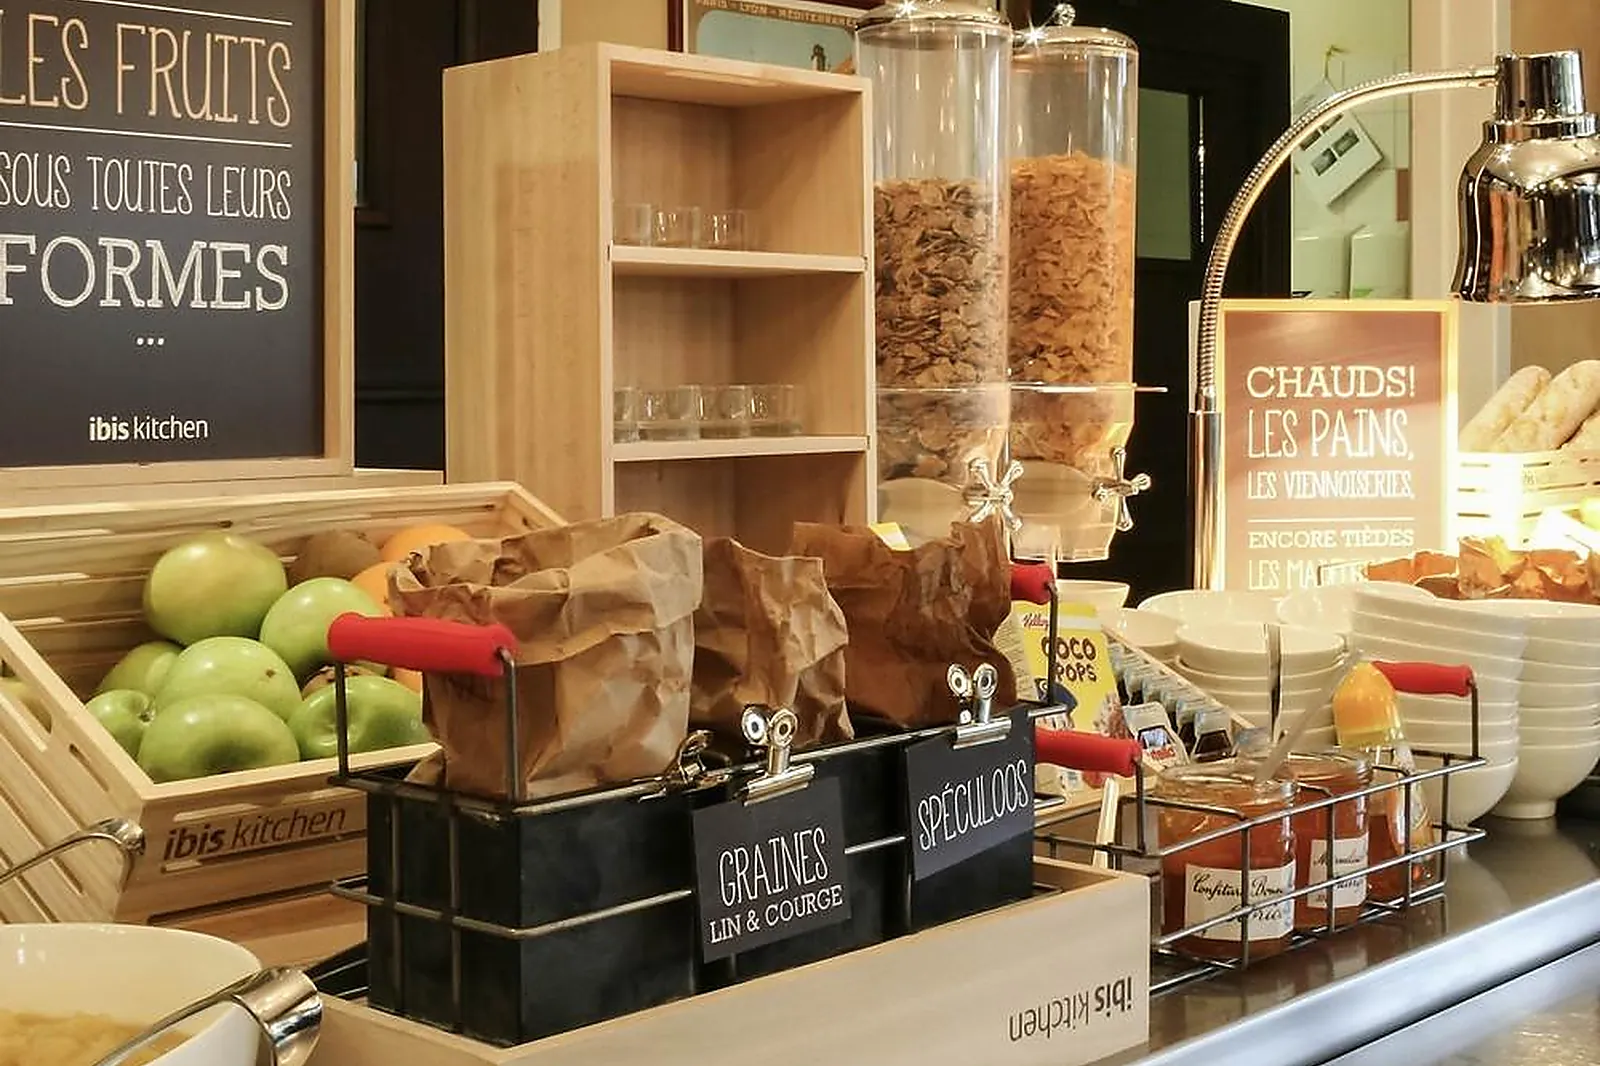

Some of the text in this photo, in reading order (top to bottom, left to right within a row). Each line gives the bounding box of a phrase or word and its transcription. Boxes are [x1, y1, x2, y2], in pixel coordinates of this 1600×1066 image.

[0, 9, 292, 127] LES FRUITS
[0, 151, 292, 220] SOUS TOUTES LEURS
[0, 234, 289, 311] FORMES
[1247, 365, 1415, 398] CHAUDS!
[89, 415, 208, 441] ibis kitchen
[1248, 408, 1414, 461] LES PAINS,
[1247, 470, 1278, 499] LES
[1248, 530, 1338, 549] ENCORE
[1248, 559, 1281, 590] LES
[1053, 662, 1097, 682] POPS
[918, 759, 1029, 851] SPÉCULOOS
[164, 807, 346, 860] ibis kitchen
[719, 827, 829, 907] GRAINES
[710, 884, 843, 944] LIN & COURGE
[1009, 976, 1132, 1042] ibis kitchen
